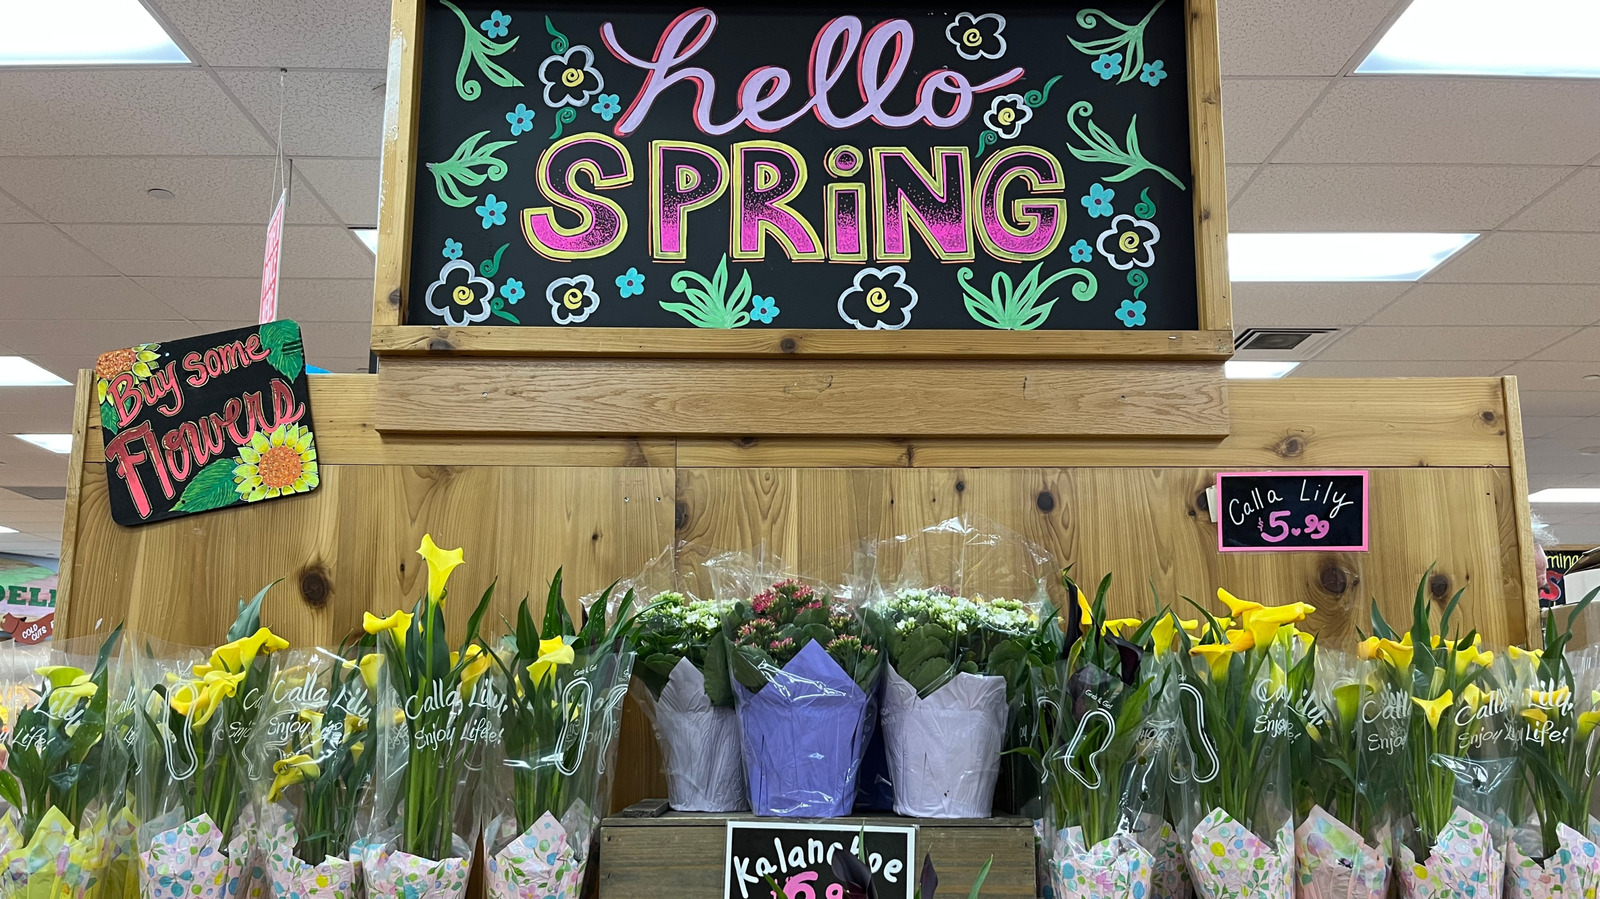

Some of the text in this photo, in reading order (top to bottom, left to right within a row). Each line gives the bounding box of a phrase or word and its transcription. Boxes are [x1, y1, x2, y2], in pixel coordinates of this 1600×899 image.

[601, 7, 1025, 136] hello
[107, 360, 184, 428] Buy
[1229, 479, 1354, 526] Calla Lily
[22, 624, 39, 639] COLD
[31, 626, 47, 641] CUTS
[273, 672, 329, 704] Calla
[404, 677, 462, 720] Calla
[267, 714, 310, 740] Enjoy
[414, 722, 456, 752] Enjoy
[1458, 726, 1503, 749] Enjoy
[1525, 720, 1569, 747] Life!
